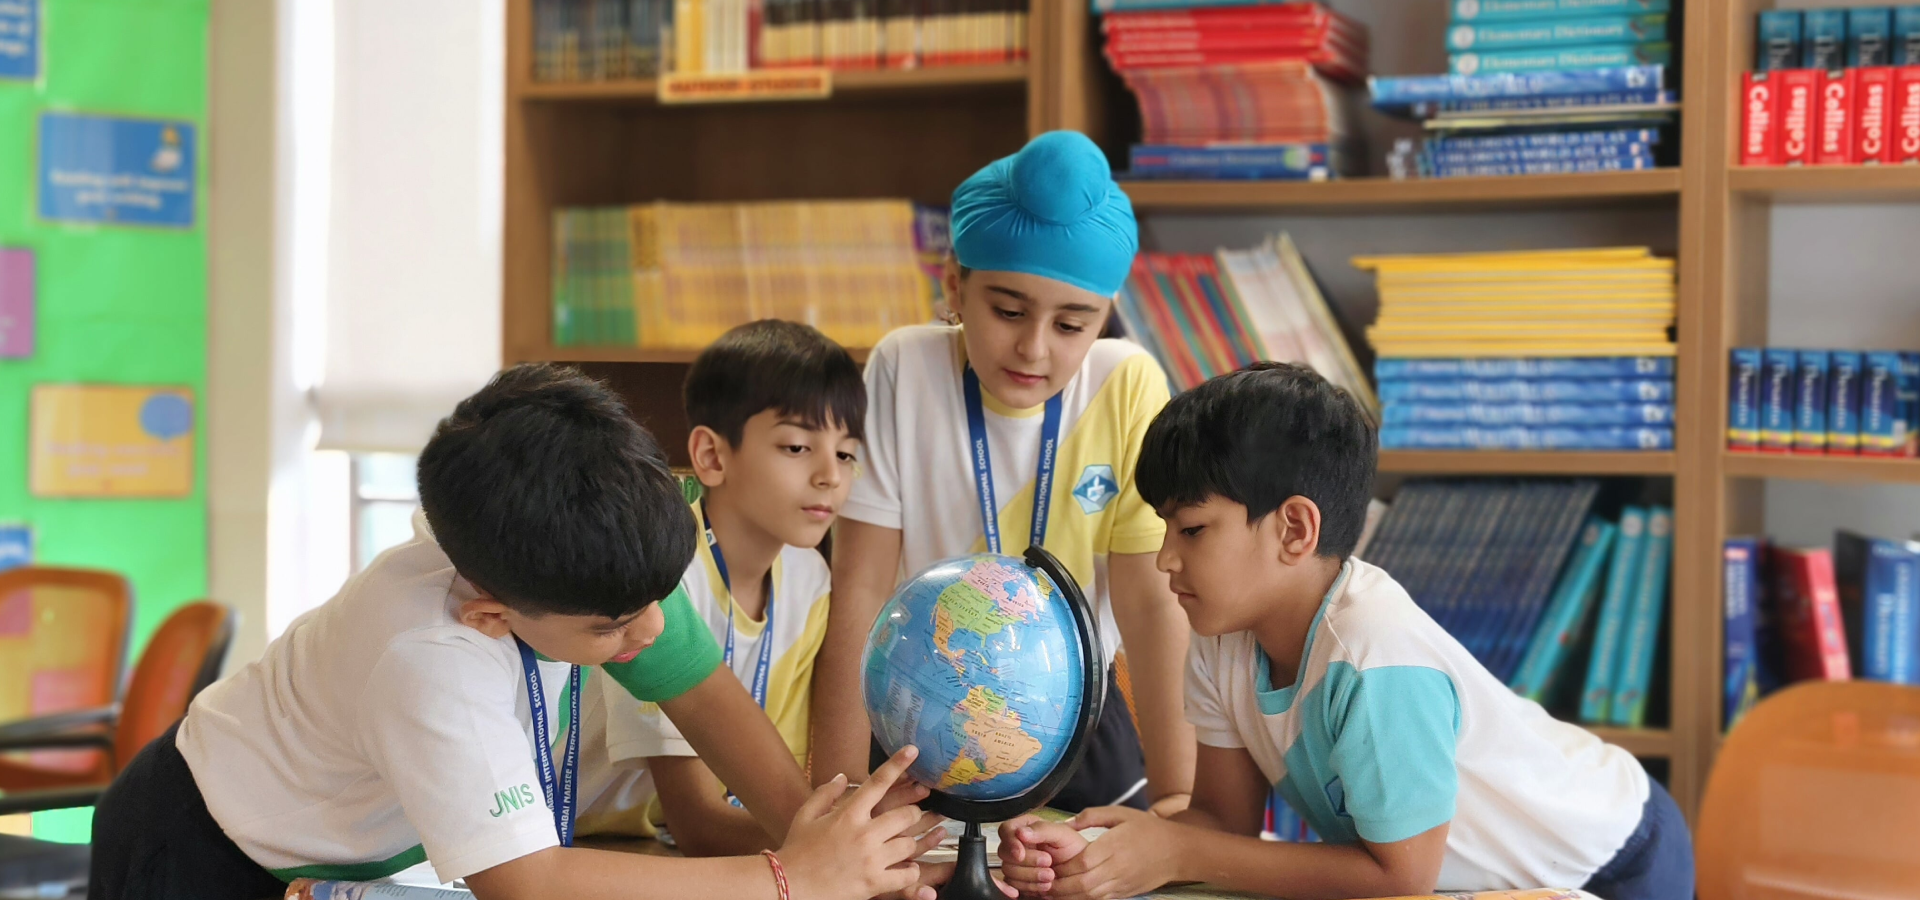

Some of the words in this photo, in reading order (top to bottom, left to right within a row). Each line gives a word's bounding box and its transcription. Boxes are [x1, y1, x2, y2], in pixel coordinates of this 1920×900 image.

[1748, 85, 1769, 154] Collins
[1785, 86, 1807, 156] Collins
[1824, 83, 1845, 153] Collins
[1862, 84, 1883, 154] Collins
[1901, 83, 1920, 153] Collins
[976, 438, 987, 470] SCHOOL
[1035, 471, 1050, 534] INTERNATIONAL
[1043, 438, 1054, 470] SCHOOL
[981, 472, 996, 534] INTERNATIONAL
[529, 669, 542, 708] SCHOOL
[536, 709, 553, 783] INTERNATIONAL
[567, 690, 577, 766] INTERNATIONAL
[489, 783, 535, 818] JNIS
[563, 768, 573, 804] NARSEE
